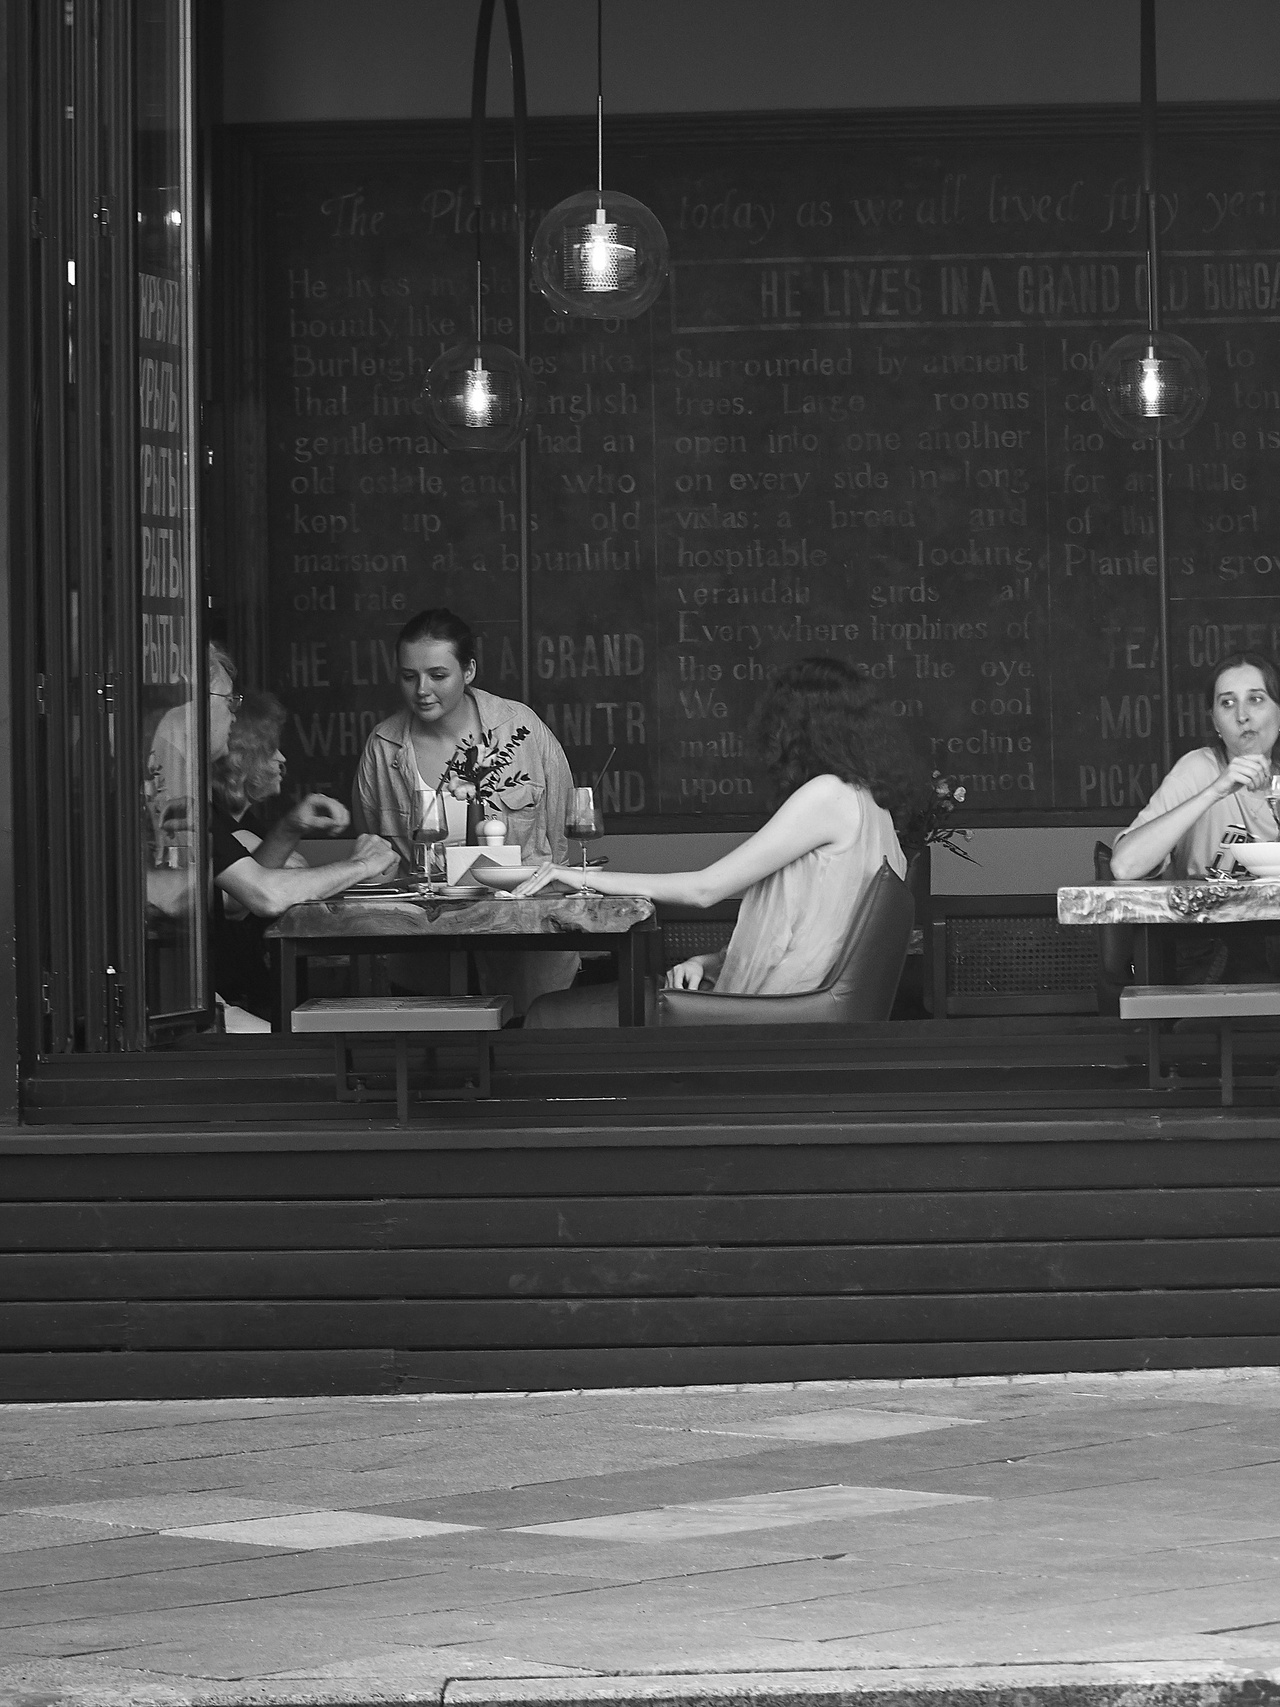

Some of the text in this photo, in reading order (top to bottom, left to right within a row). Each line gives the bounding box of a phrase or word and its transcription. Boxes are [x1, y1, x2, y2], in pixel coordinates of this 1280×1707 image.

[320, 185, 385, 237] The
[680, 188, 776, 245] today
[796, 200, 833, 228] as
[851, 198, 904, 227] we
[989, 173, 1085, 224] lived
[1100, 178, 1179, 234] fify
[289, 268, 328, 298] He
[760, 270, 802, 318] HE
[822, 267, 923, 316] LIVES
[1017, 264, 1120, 314] GRAND
[1134, 263, 1188, 311] OD
[409, 304, 456, 336] like
[674, 343, 1028, 381] Surrounded by ancient
[1225, 340, 1255, 368] to
[676, 387, 754, 416] trees.
[777, 383, 866, 422] Large
[933, 390, 1030, 412] rooms
[537, 424, 635, 453] had an
[675, 421, 1031, 463] open into one another
[1213, 422, 1247, 450] he
[290, 466, 336, 495] old
[460, 464, 519, 495] and
[561, 464, 636, 494] who
[674, 473, 713, 493] on
[728, 471, 811, 500] every
[834, 462, 890, 490] side
[963, 460, 1031, 494] long
[1063, 463, 1106, 494] for
[293, 499, 641, 542] kept up hs old
[776, 511, 793, 529] a
[828, 500, 917, 530] broad
[968, 498, 1028, 527] and
[1065, 506, 1093, 535] of
[1120, 504, 1156, 536] thi
[293, 550, 408, 573] mansion
[471, 552, 487, 572] a
[677, 537, 828, 575] hospitable
[293, 585, 337, 612] old
[869, 576, 941, 609] girds
[999, 576, 1031, 600] all
[678, 610, 860, 650] Everywhere
[1006, 610, 1034, 641] of
[290, 638, 399, 689] HE LIV
[536, 632, 646, 681] GRAND
[677, 655, 723, 682] the
[915, 653, 956, 679] the
[679, 687, 729, 719] We
[891, 687, 1033, 717] on cool
[929, 728, 1033, 755] recline
[680, 777, 754, 804] upon
